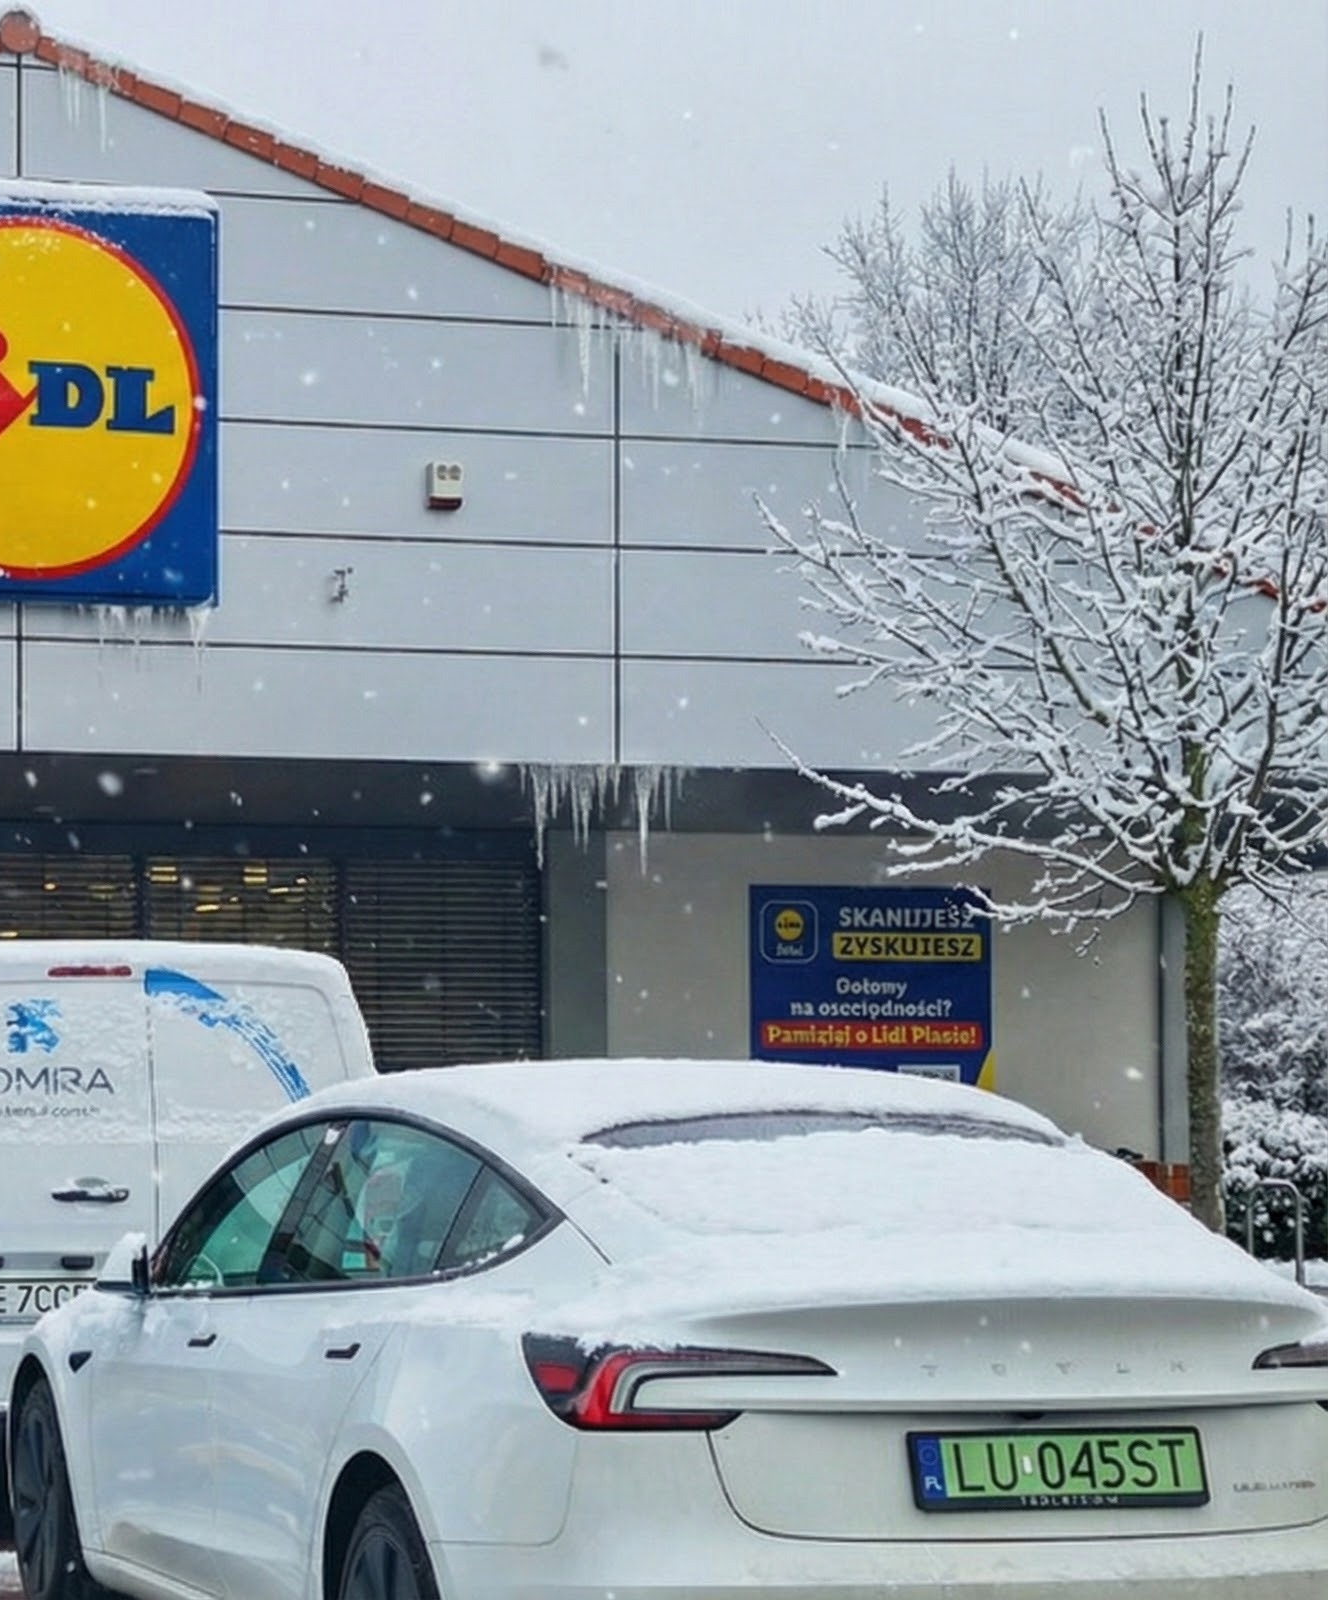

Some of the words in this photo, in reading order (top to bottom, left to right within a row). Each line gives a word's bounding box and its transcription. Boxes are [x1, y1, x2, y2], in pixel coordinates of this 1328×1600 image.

[790, 1001, 814, 1016] na
[856, 1030, 867, 1043] o
[871, 1025, 907, 1044] Lidl
[953, 1441, 1018, 1493] LU
[1037, 1438, 1186, 1491] 045ST
